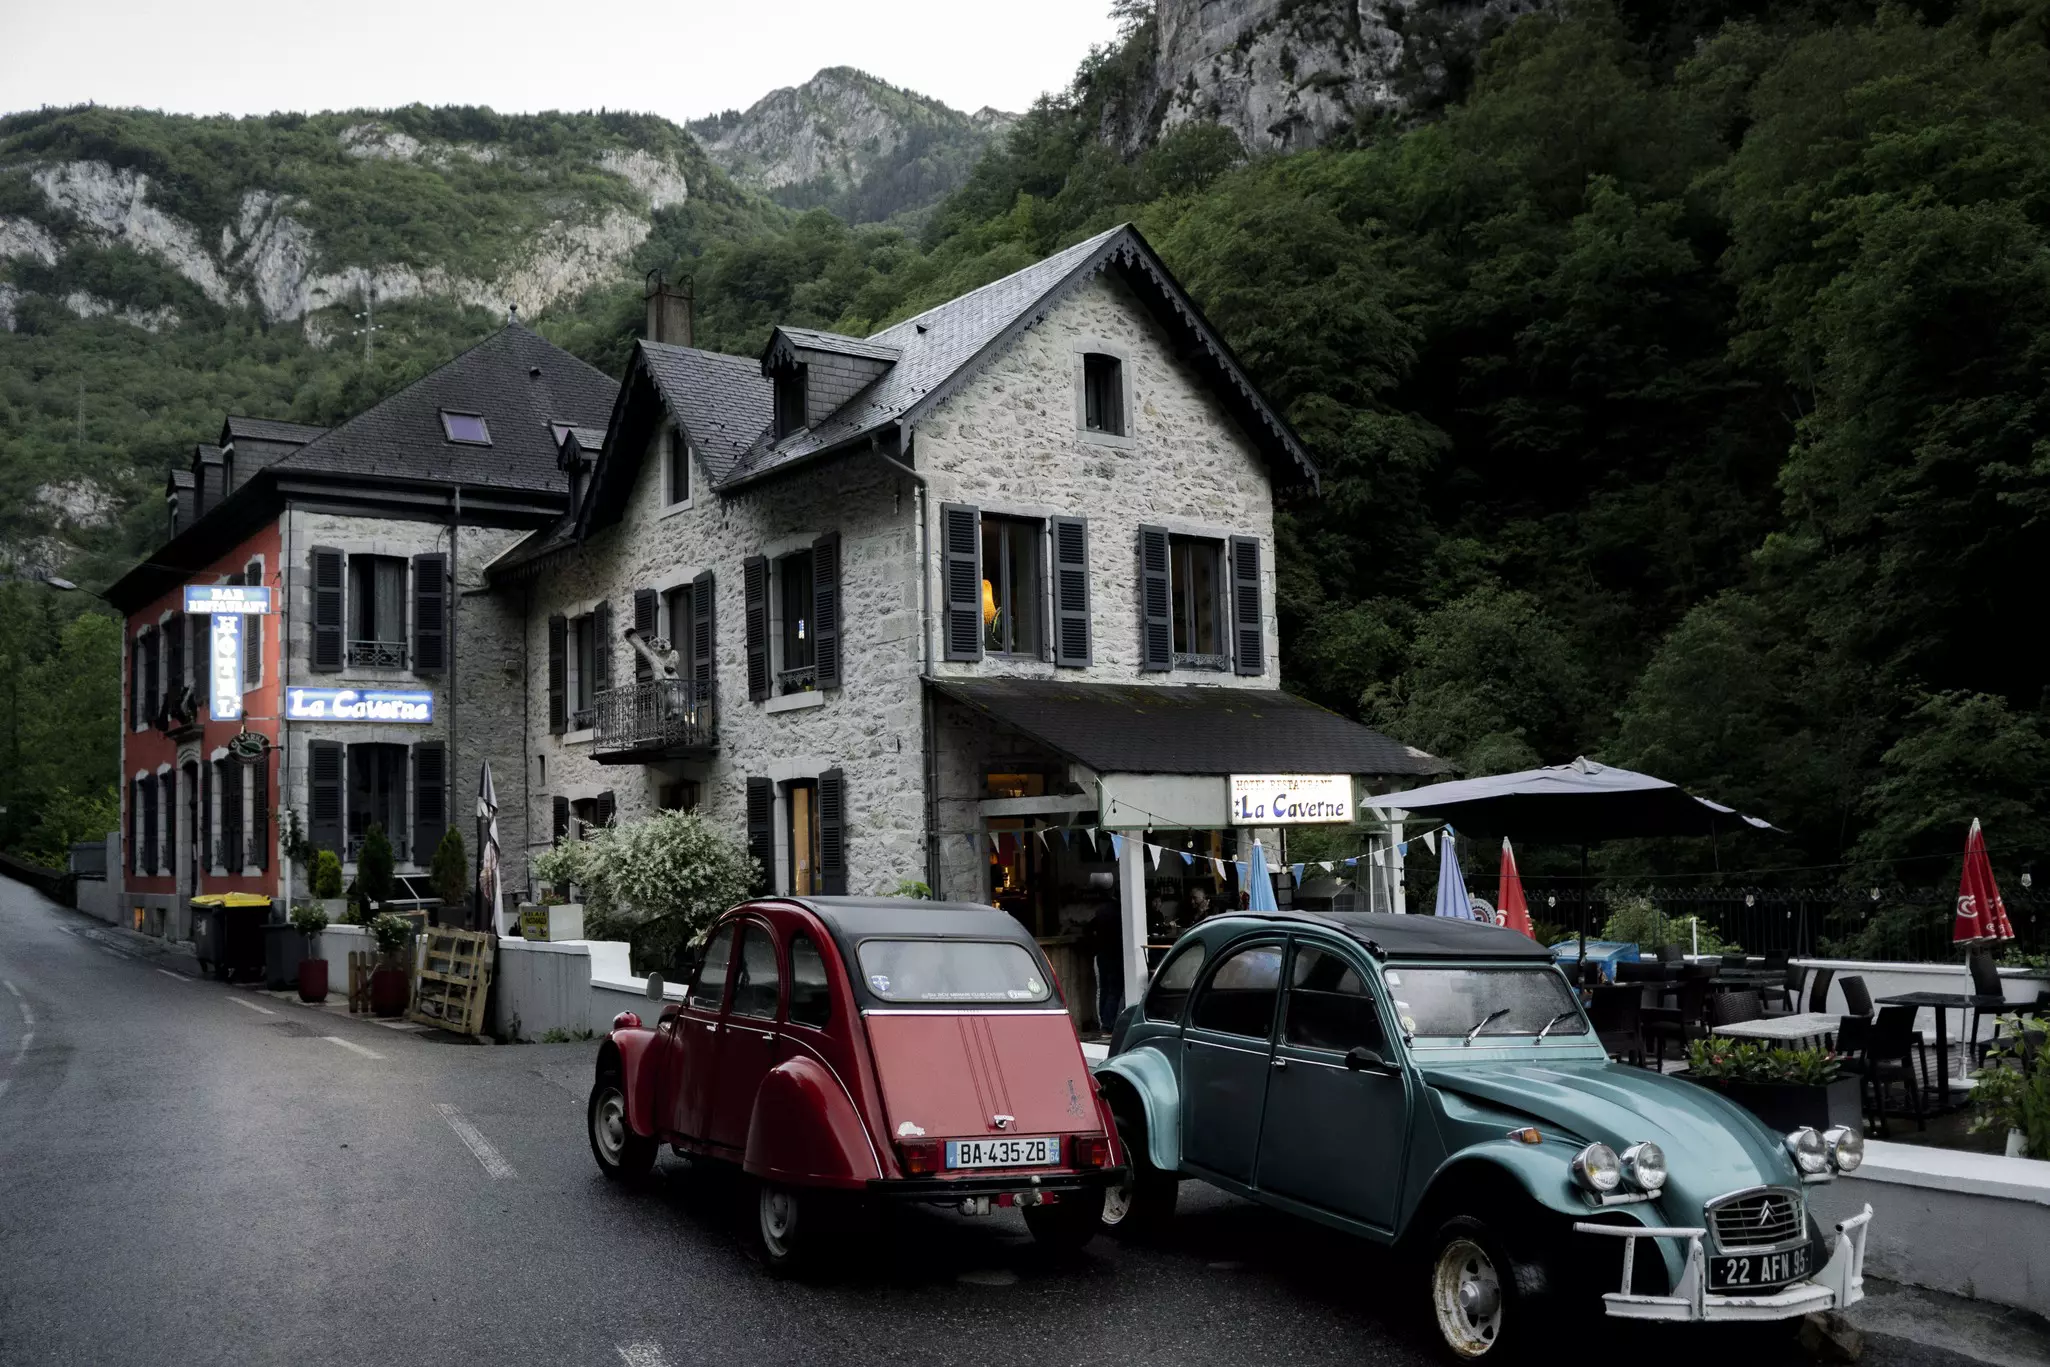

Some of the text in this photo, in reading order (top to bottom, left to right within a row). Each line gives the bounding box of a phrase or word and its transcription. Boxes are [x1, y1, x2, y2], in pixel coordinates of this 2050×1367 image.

[188, 600, 267, 613] RESTAURANT
[211, 588, 245, 601] BAR
[291, 690, 429, 719] La Caverne
[1235, 779, 1265, 791] HOTEL
[1241, 793, 1345, 819] La Caverne
[960, 1141, 1047, 1165] BA-435-ZB
[1726, 1247, 1806, 1285] 22 AFN 95
